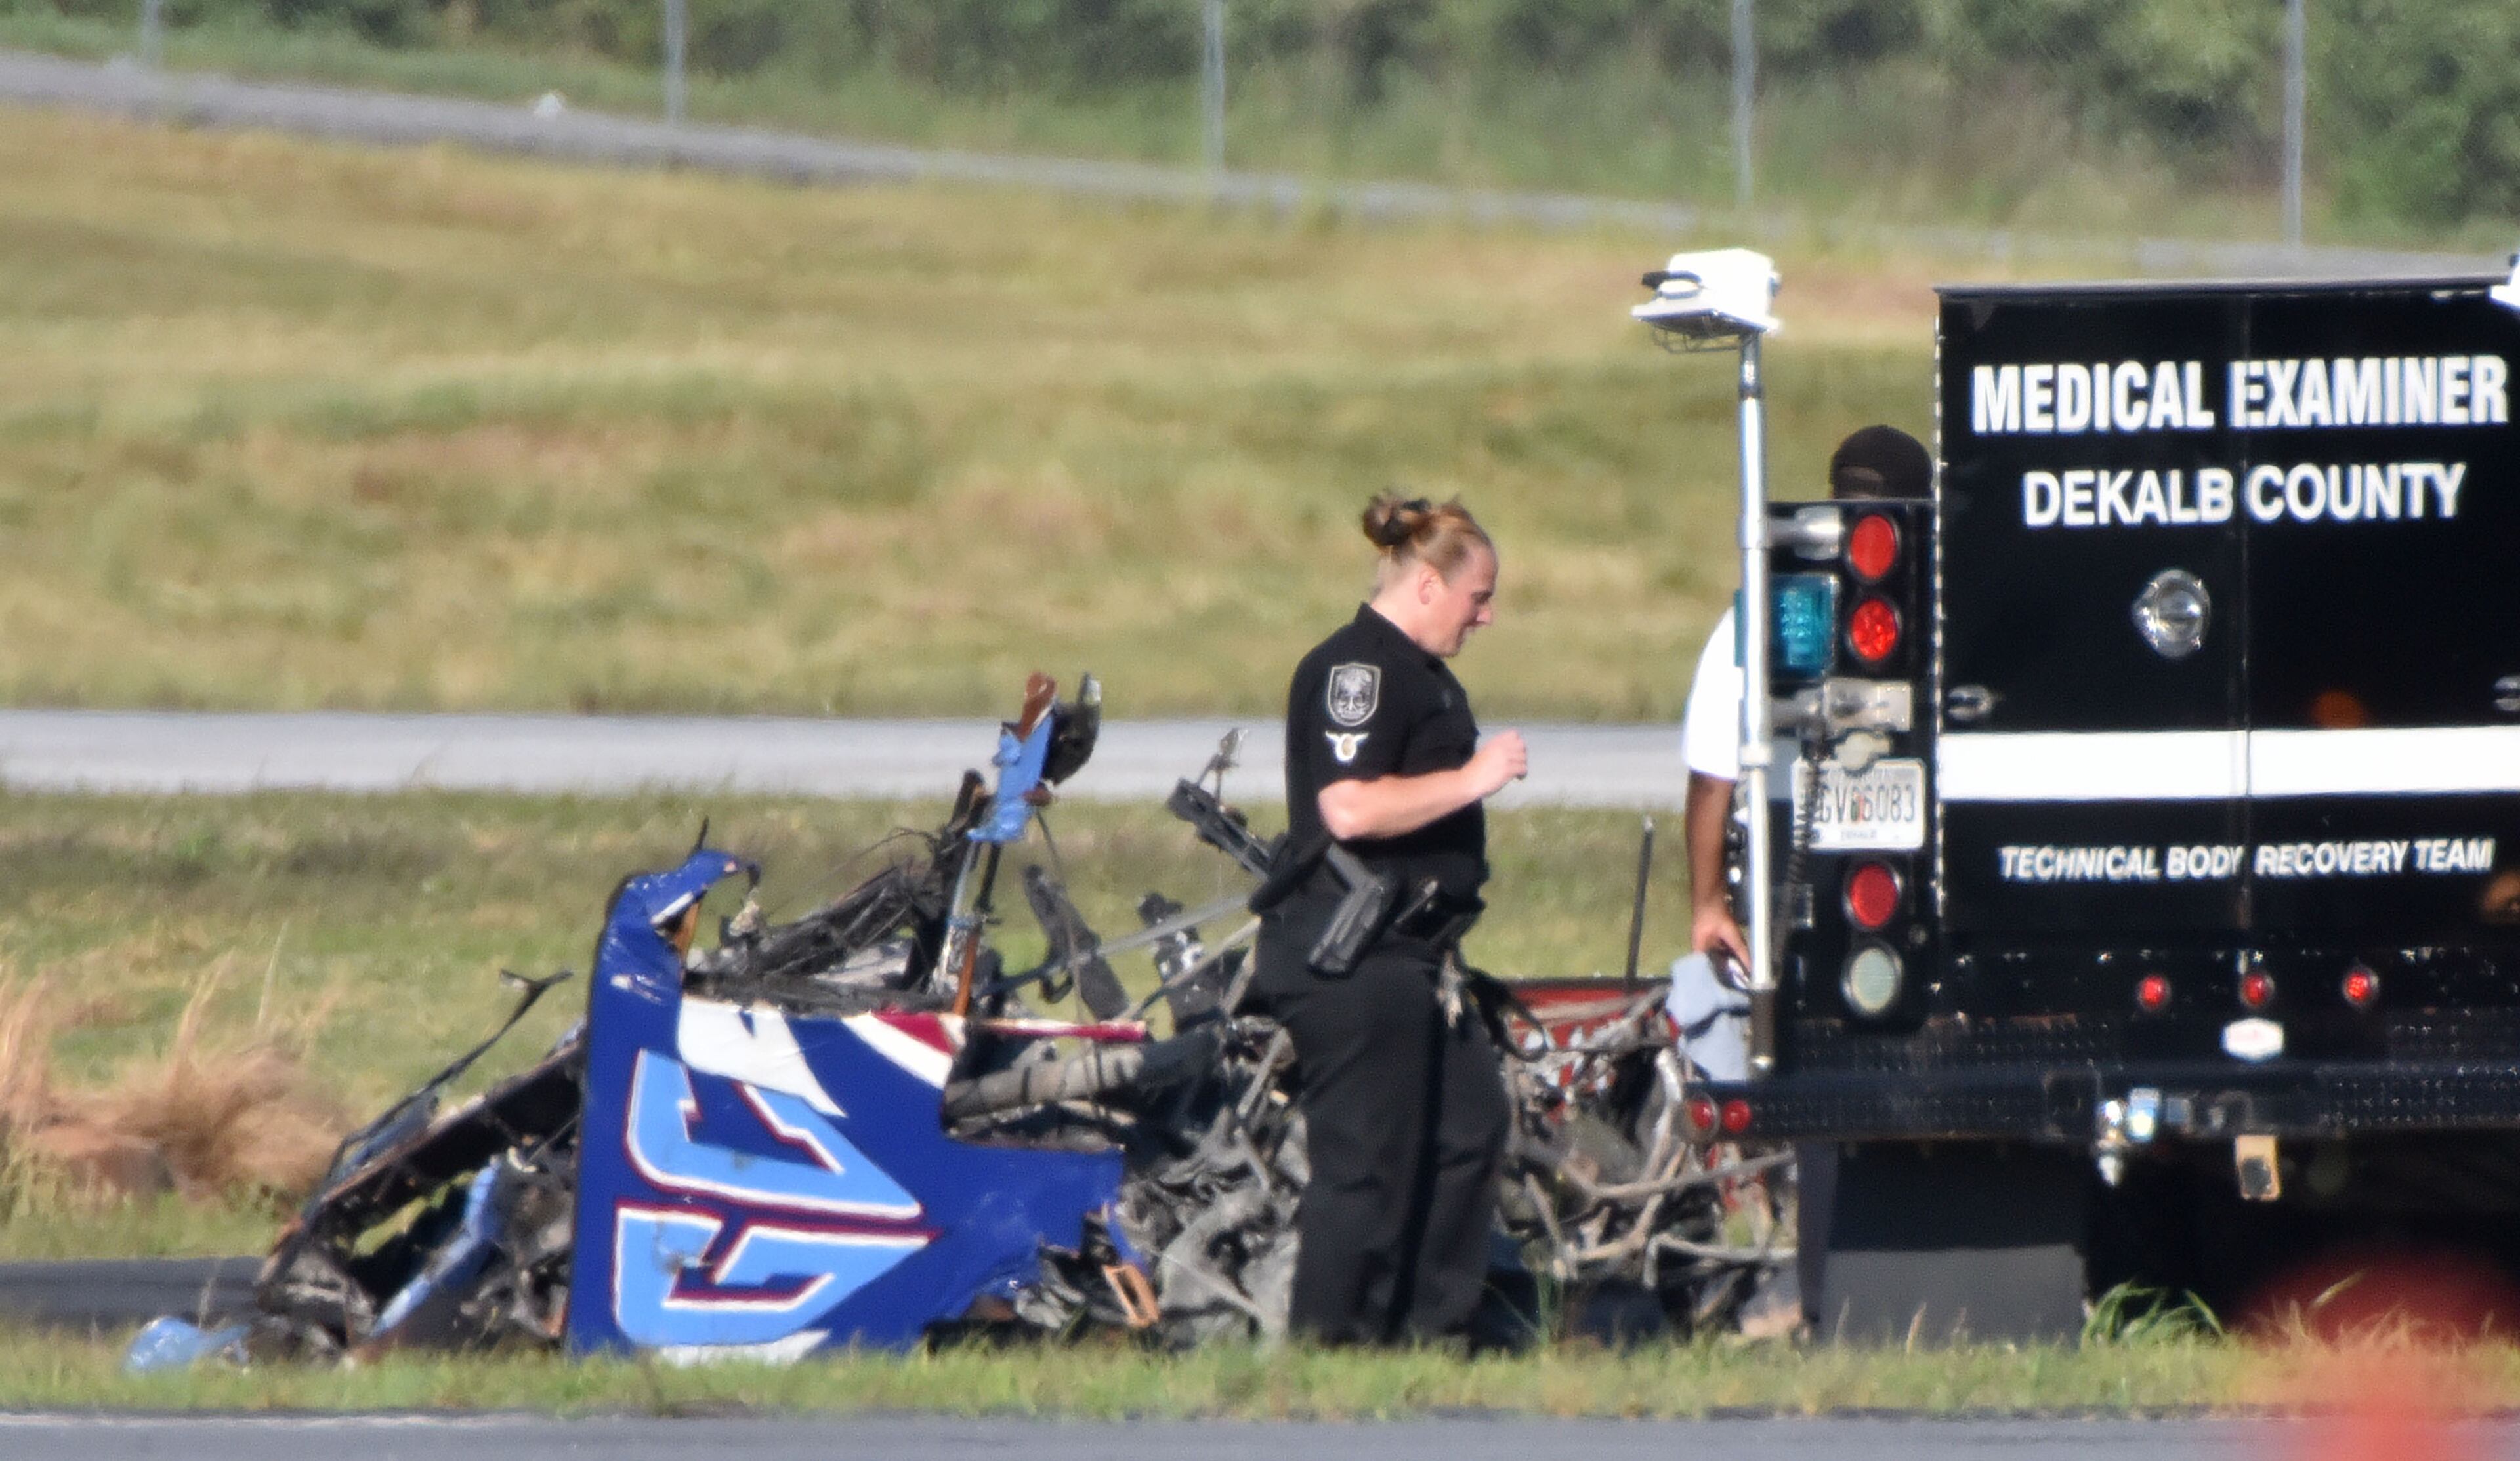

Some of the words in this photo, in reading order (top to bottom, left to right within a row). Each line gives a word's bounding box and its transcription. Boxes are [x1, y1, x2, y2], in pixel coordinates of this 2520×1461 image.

[1972, 360, 2216, 433] MEDICAL
[2229, 354, 2508, 428] EXAMINER
[2023, 467, 2233, 527] DEKALB
[2244, 462, 2467, 522] COUNTY
[2000, 846, 2161, 881] TECHNICAL
[2166, 844, 2244, 880] BODY
[2254, 840, 2410, 876] RECOVERY
[2414, 838, 2495, 872] TEAM
